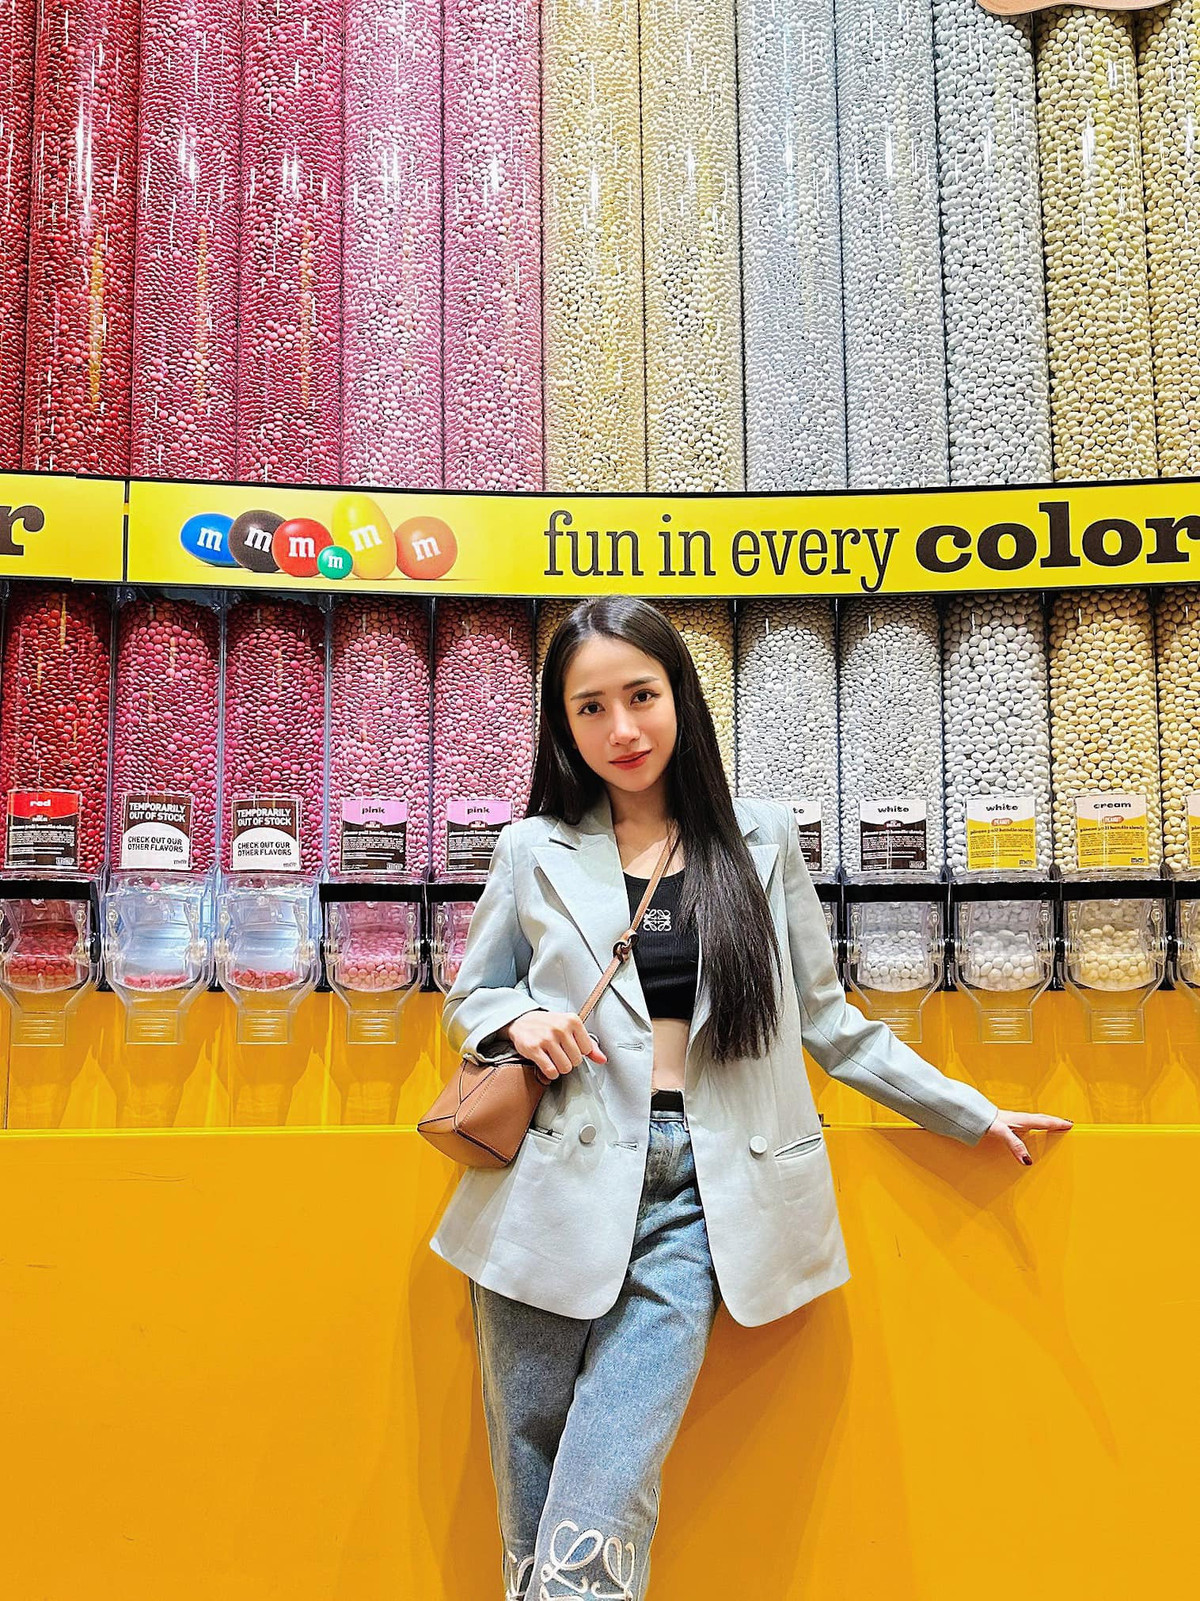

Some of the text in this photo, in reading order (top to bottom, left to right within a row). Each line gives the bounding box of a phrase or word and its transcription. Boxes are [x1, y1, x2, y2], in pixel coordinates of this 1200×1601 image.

[196, 526, 223, 552] m
[349, 523, 382, 552] m
[288, 534, 316, 559] m
[411, 536, 441, 562] m
[543, 501, 1200, 593] fun in every color
[327, 554, 344, 570] m
[29, 799, 52, 807] red
[985, 803, 1019, 812] white
[1093, 801, 1132, 809] cream
[129, 803, 186, 813] TEMPORARILY
[236, 808, 292, 817] TEMPORARILY
[361, 806, 386, 815] pink
[467, 806, 490, 815] pink
[877, 805, 910, 813] white
[129, 811, 186, 822] OUT OF STOCK
[237, 817, 292, 826] OUT OF STOCK
[151, 837, 165, 845] OUT
[167, 838, 182, 846] OUR
[260, 841, 274, 849] OUT
[275, 841, 290, 849] OUR
[127, 843, 183, 853] OTHER FLAVORS
[237, 848, 292, 857] OTHER FLAVORS
